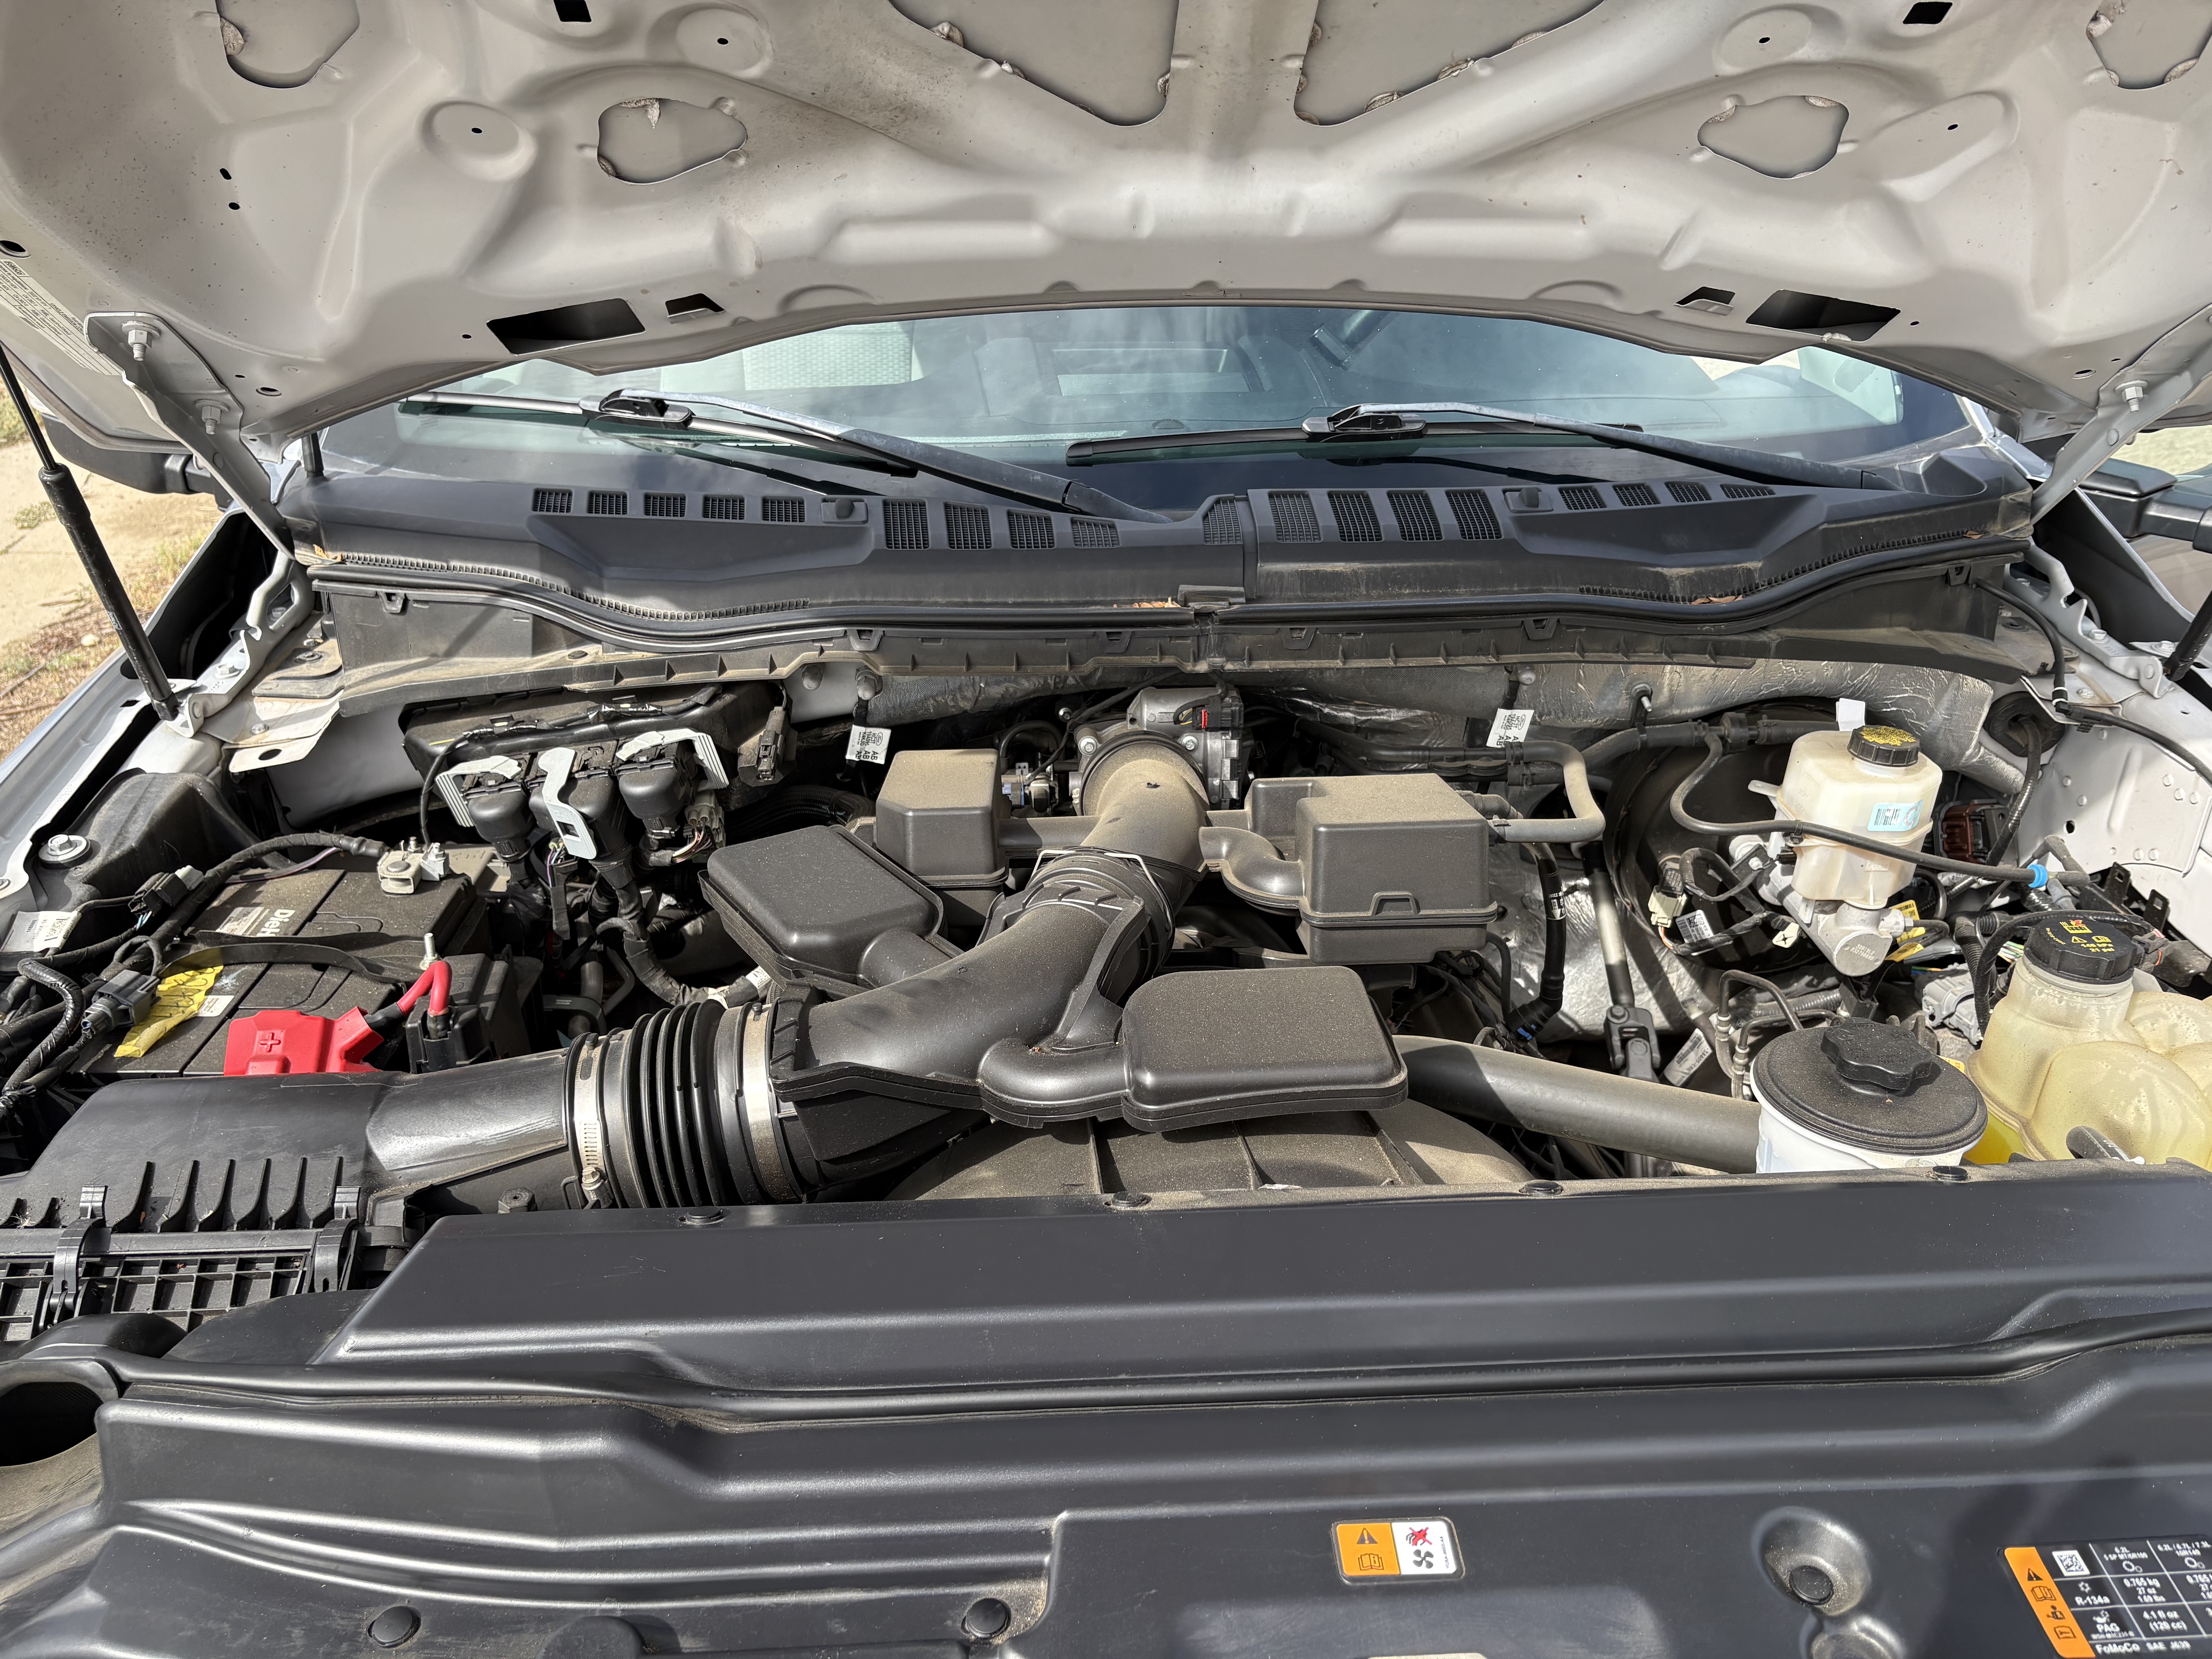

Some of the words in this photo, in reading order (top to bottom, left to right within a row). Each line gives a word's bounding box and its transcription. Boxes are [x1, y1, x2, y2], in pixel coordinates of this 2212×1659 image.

[1496, 735, 1504, 746] AB
[855, 751, 862, 759] AB
[863, 750, 870, 759] AB
[871, 751, 878, 760] AB
[256, 909, 296, 936] DieH
[2123, 1578, 2147, 1588] 0.765
[2146, 1577, 2161, 1589] kg
[2186, 1574, 2210, 1585] 0.765
[2136, 1587, 2146, 1595] 27
[2075, 1595, 2110, 1606] R-134a
[2143, 1611, 2157, 1620] 4.1
[2167, 1611, 2180, 1620] oz
[2096, 1623, 2120, 1633] PAG
[2171, 1620, 2188, 1632] cc)
[2095, 1642, 2141, 1654] FoMoCo
[2146, 1642, 2167, 1652] SAE
